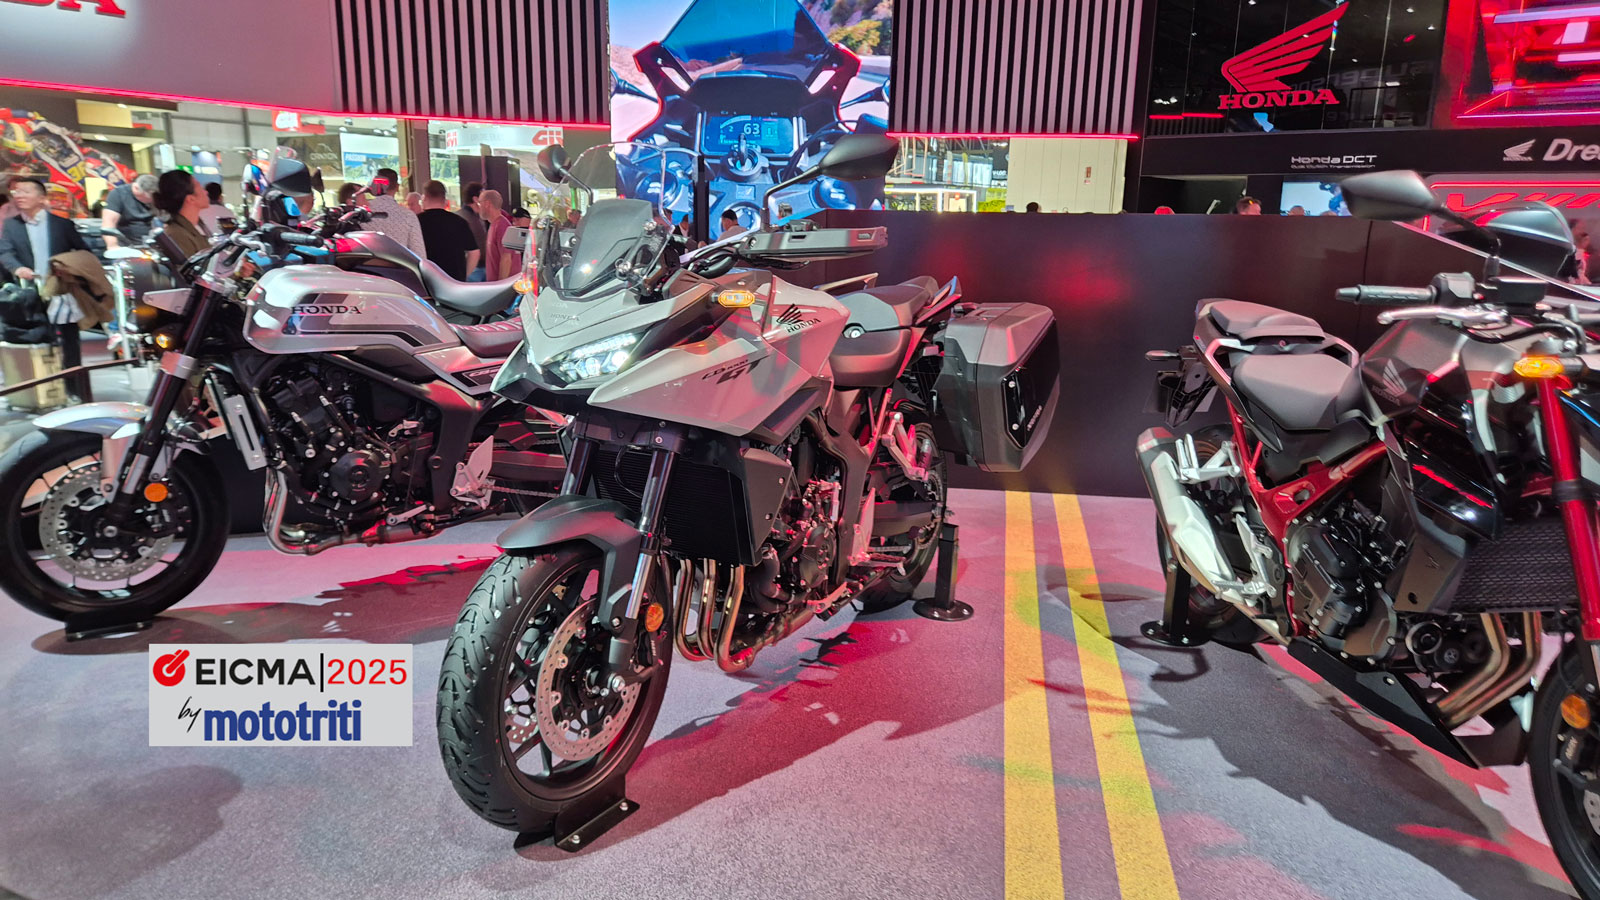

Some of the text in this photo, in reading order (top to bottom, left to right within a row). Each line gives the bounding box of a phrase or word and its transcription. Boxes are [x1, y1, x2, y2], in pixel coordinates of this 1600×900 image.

[1217, 89, 1340, 110] HONDA
[743, 123, 760, 135] 63
[1542, 138, 1600, 161] Dre
[1291, 155, 1377, 164] Honda DCT
[291, 305, 362, 314] HONDA
[787, 318, 822, 333] HONDA
[1371, 384, 1401, 407] HONDA
